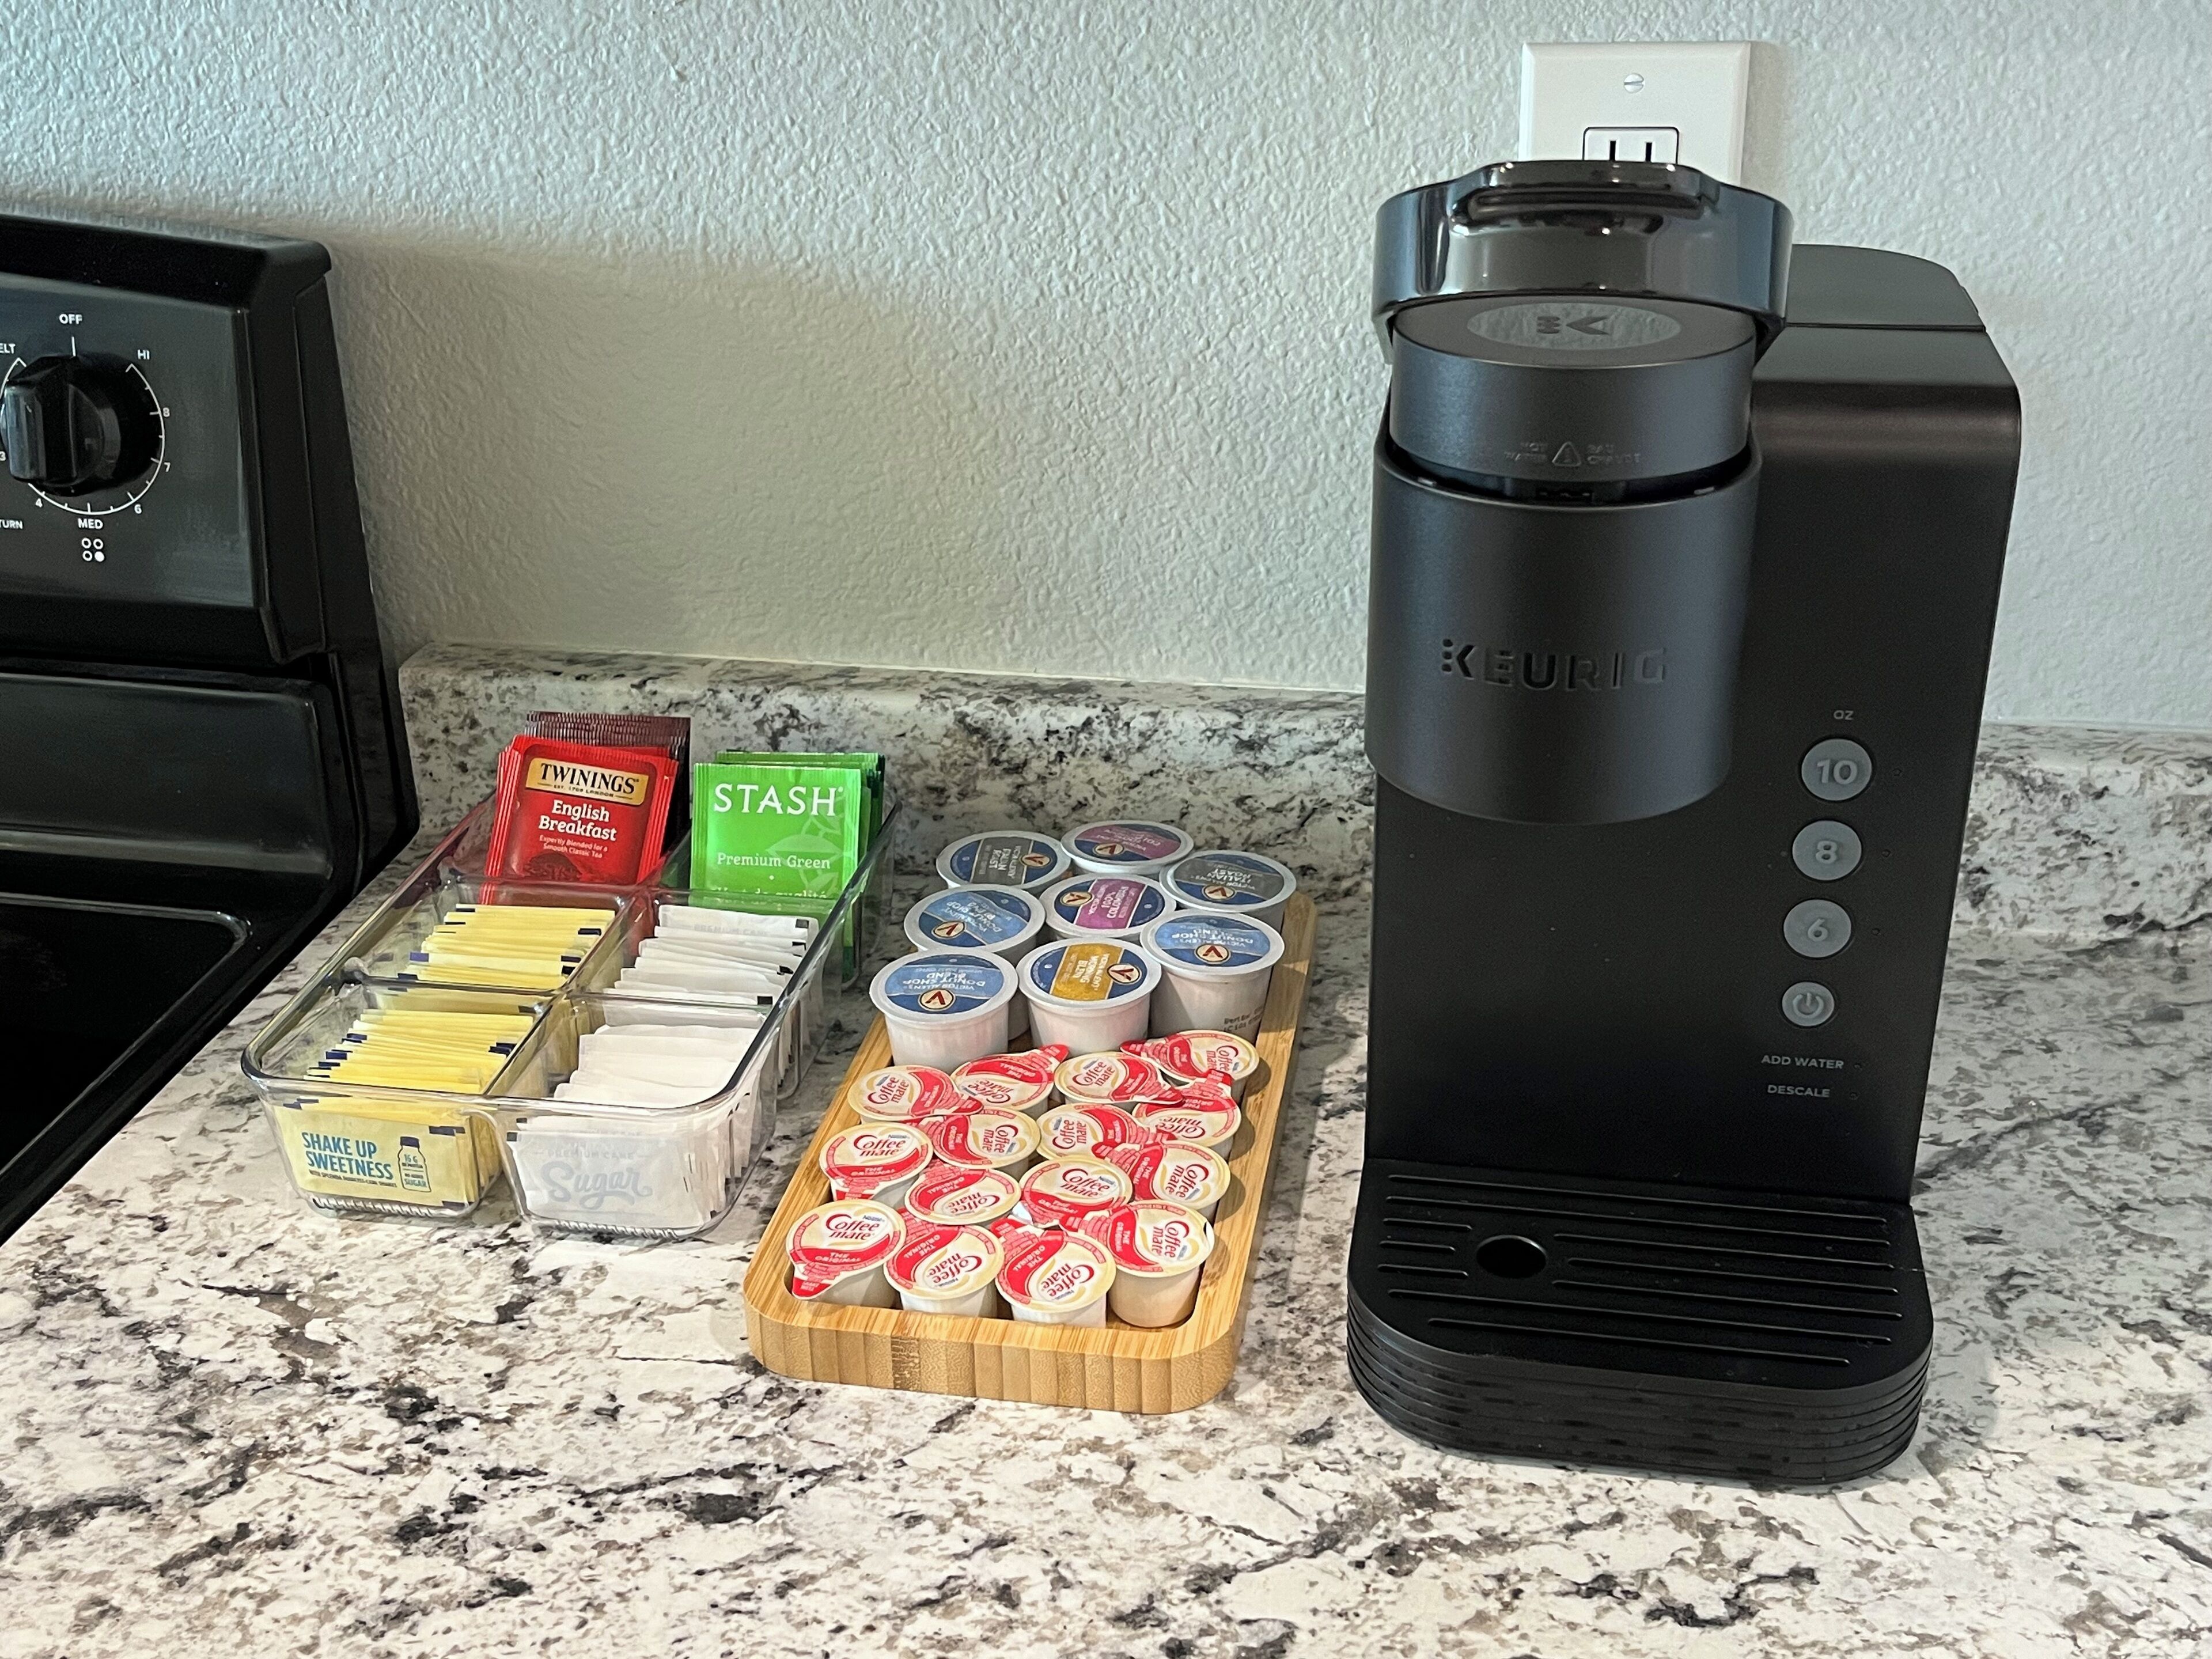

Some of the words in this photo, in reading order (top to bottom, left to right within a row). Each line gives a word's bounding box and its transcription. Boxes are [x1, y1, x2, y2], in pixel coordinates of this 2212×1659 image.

[59, 313, 82, 324] OFF
[0, 343, 16, 354] ELT
[137, 350, 150, 360] HI
[162, 408, 171, 417] 8
[164, 463, 171, 472] 7
[35, 498, 43, 507] 4
[134, 504, 142, 514] 6
[78, 518, 103, 529] MED
[1441, 638, 1666, 690] KEURIG
[1834, 710, 1854, 720] OZ
[541, 763, 634, 794] TWININGS
[1817, 759, 1858, 785] 10
[551, 799, 609, 822] English
[714, 783, 837, 816] STASH
[539, 815, 618, 841] Breakfast
[717, 852, 781, 867] Premium
[787, 855, 831, 869] Green
[1815, 840, 1838, 863] 8
[1208, 933, 1253, 943] DONUT
[1807, 918, 1828, 942] 6
[939, 977, 985, 986] DONUT
[1072, 1061, 1107, 1085] Coffee
[1761, 1055, 1791, 1066] ADD
[1795, 1057, 1844, 1069] WATER
[979, 1080, 1014, 1093] mate
[1094, 1066, 1115, 1086] mate
[868, 1077, 899, 1104] Coffee
[892, 1080, 909, 1103] mate
[1767, 1084, 1831, 1098] DESCALE
[1077, 1120, 1086, 1144] mate
[1164, 1116, 1202, 1126] mate
[302, 1132, 353, 1157] SHAKE
[355, 1140, 377, 1159] UP
[854, 1134, 906, 1150] Coffee
[982, 1129, 994, 1152] mate
[995, 1124, 1018, 1153] Coffee
[1052, 1119, 1075, 1149] Coffee
[306, 1150, 393, 1180] SWEETNESS
[404, 1154, 412, 1162] 16
[541, 1161, 652, 1210] Sugar
[1060, 1183, 1099, 1198] mate
[1062, 1168, 1110, 1192] Coffee
[1165, 1165, 1184, 1194] mate
[1176, 1164, 1209, 1198] Coffee
[948, 1192, 981, 1208] mate
[951, 1195, 1000, 1214] Coffee
[826, 1213, 880, 1232] Coffee
[829, 1230, 872, 1240] mate
[903, 1234, 941, 1259] ORIGINAL
[1152, 1226, 1163, 1256] mate
[1164, 1220, 1190, 1258] Coffee
[918, 1245, 936, 1256] THE
[1012, 1245, 1046, 1271] ORIGINAL
[1027, 1256, 1044, 1268] THE
[929, 1253, 961, 1276] mate
[933, 1255, 982, 1283] Coffee
[1040, 1263, 1073, 1289] mate
[1047, 1264, 1094, 1297] Coffee
